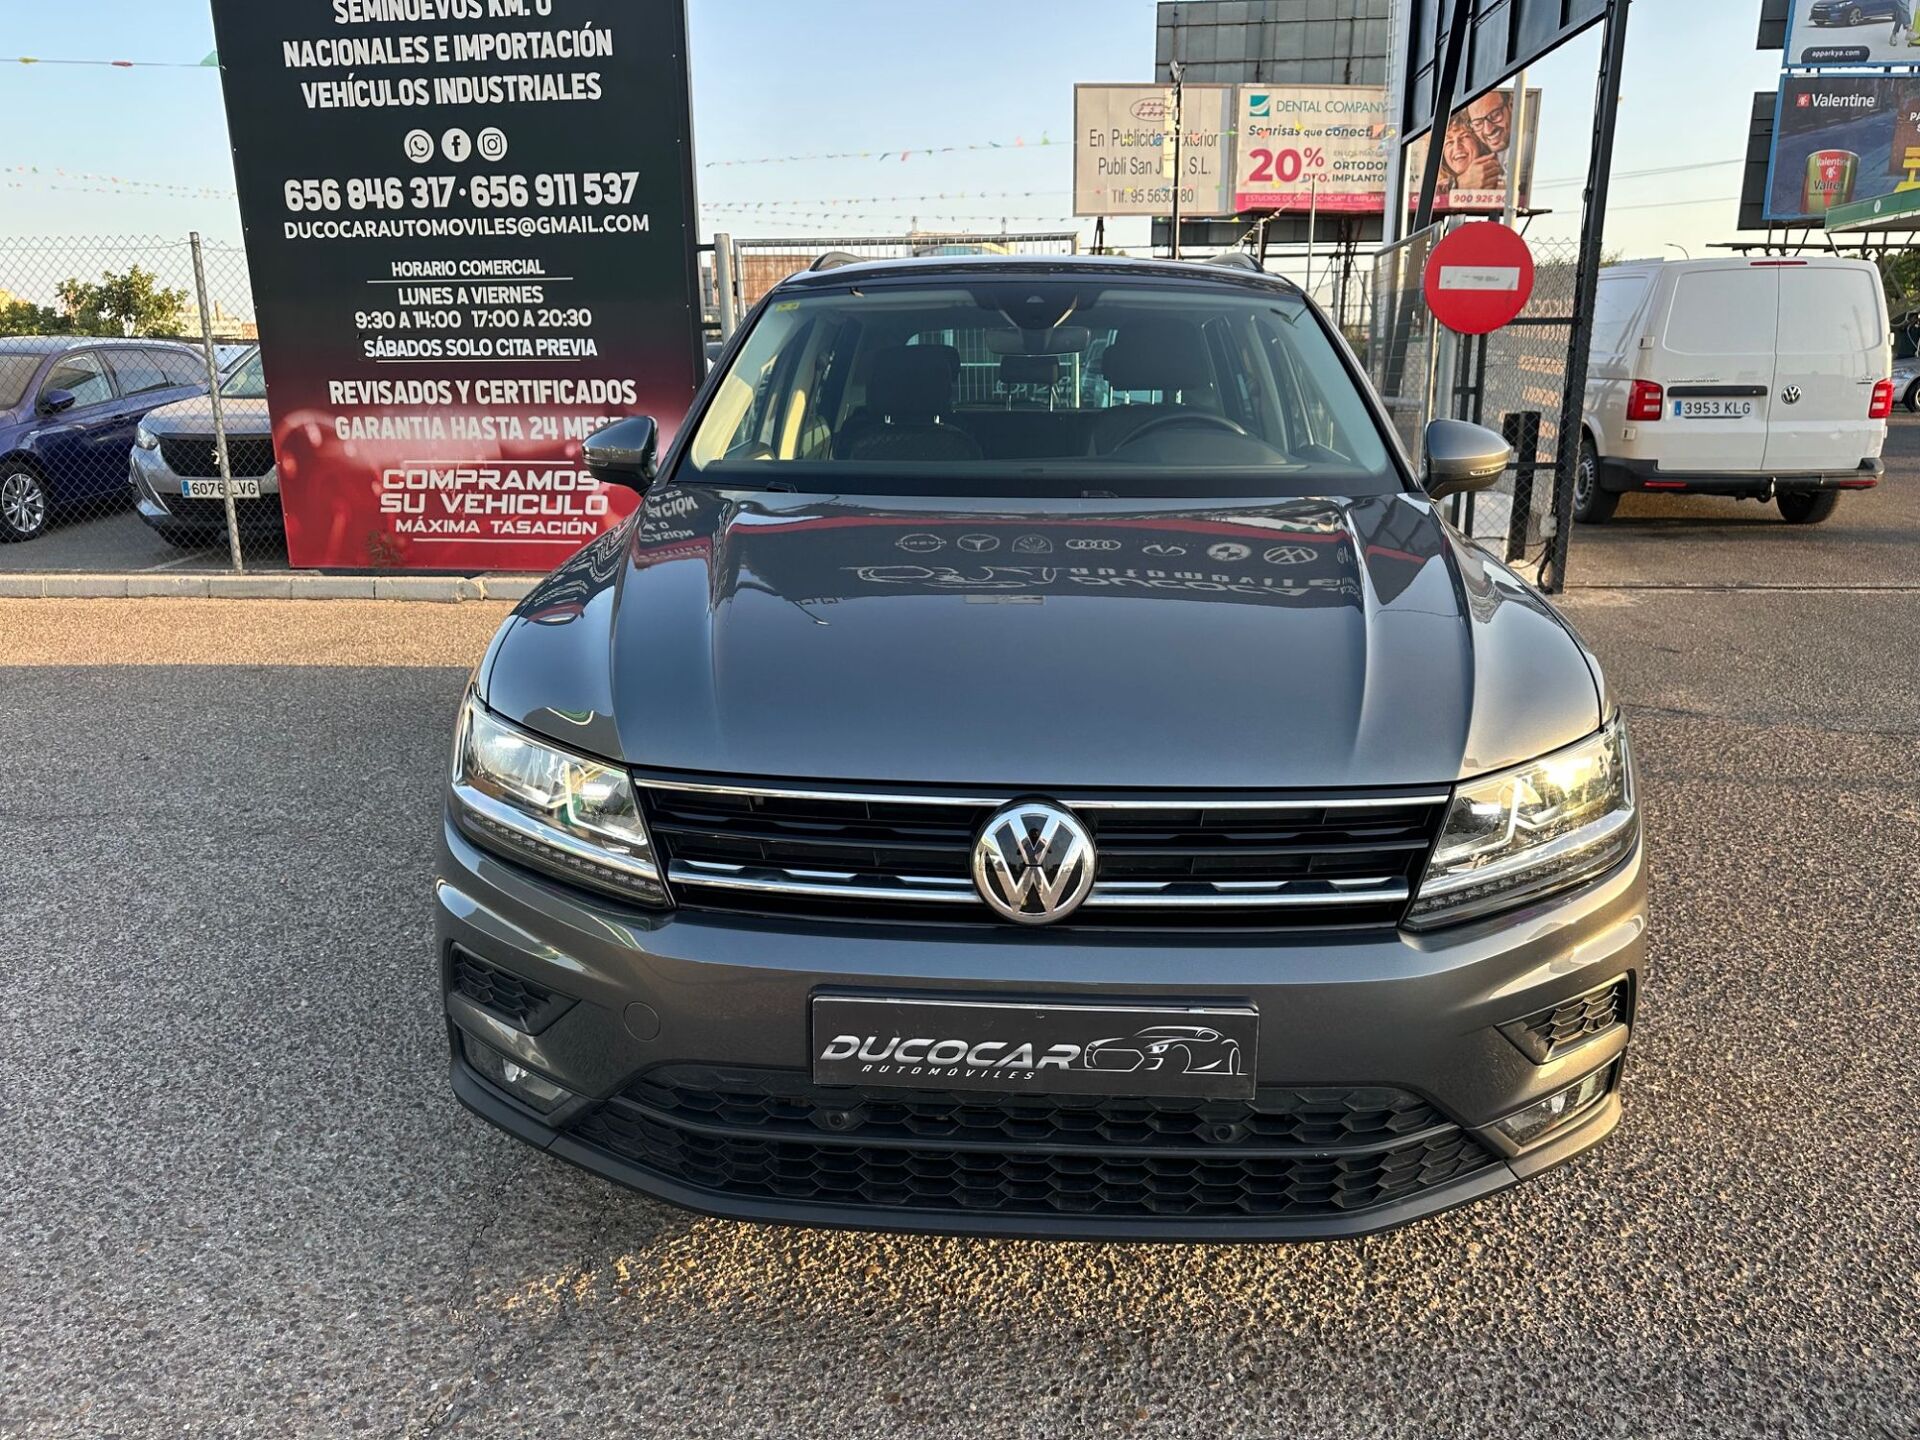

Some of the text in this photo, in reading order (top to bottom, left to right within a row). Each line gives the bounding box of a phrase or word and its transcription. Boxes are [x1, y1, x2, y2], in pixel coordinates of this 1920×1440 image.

[334, 0, 483, 24] SEMINUEVOS
[283, 21, 613, 68] NACIONALES E IMPORTACIÓN
[1812, 49, 1860, 58] apparkya.com
[300, 72, 602, 109] VEHÍCULOS INDUSTRIALES
[1276, 99, 1387, 113] DENTAL COMPANY
[1812, 94, 1875, 108] Valentine
[1090, 128, 1104, 147] En
[1304, 128, 1322, 138] que
[1098, 156, 1127, 176] Publi
[1130, 156, 1152, 176] San
[1189, 157, 1212, 175] S.L.
[284, 179, 341, 211] 656
[347, 177, 403, 210] 846
[534, 173, 577, 207] 911
[583, 171, 640, 206] 537
[1131, 189, 1147, 203] 95
[1453, 194, 1473, 203] 900
[284, 214, 649, 239] DUCOCARAUTOMOVILES@GMAIL.COM
[391, 259, 545, 277] HORARIO COMERCIAL
[398, 286, 544, 305] LUNES A VIERNES
[355, 308, 592, 329] 9:30 A 14:00 17:00 A 20:30
[363, 336, 598, 358] SÁBADOS SOLO CITA PREVIA
[328, 379, 638, 405] REVISADOS Y CERTIFICADOS
[1684, 401, 1751, 415] 3953 KLG
[335, 416, 446, 440] GARANTIA
[450, 416, 524, 440] HASTA
[528, 416, 559, 440] 24
[383, 469, 600, 491] COMPRAMOS
[380, 492, 609, 516] SU VEHICULO
[395, 516, 597, 535] MÁXIMA TASACIÓN
[820, 1035, 1082, 1071] DUCOCAR
